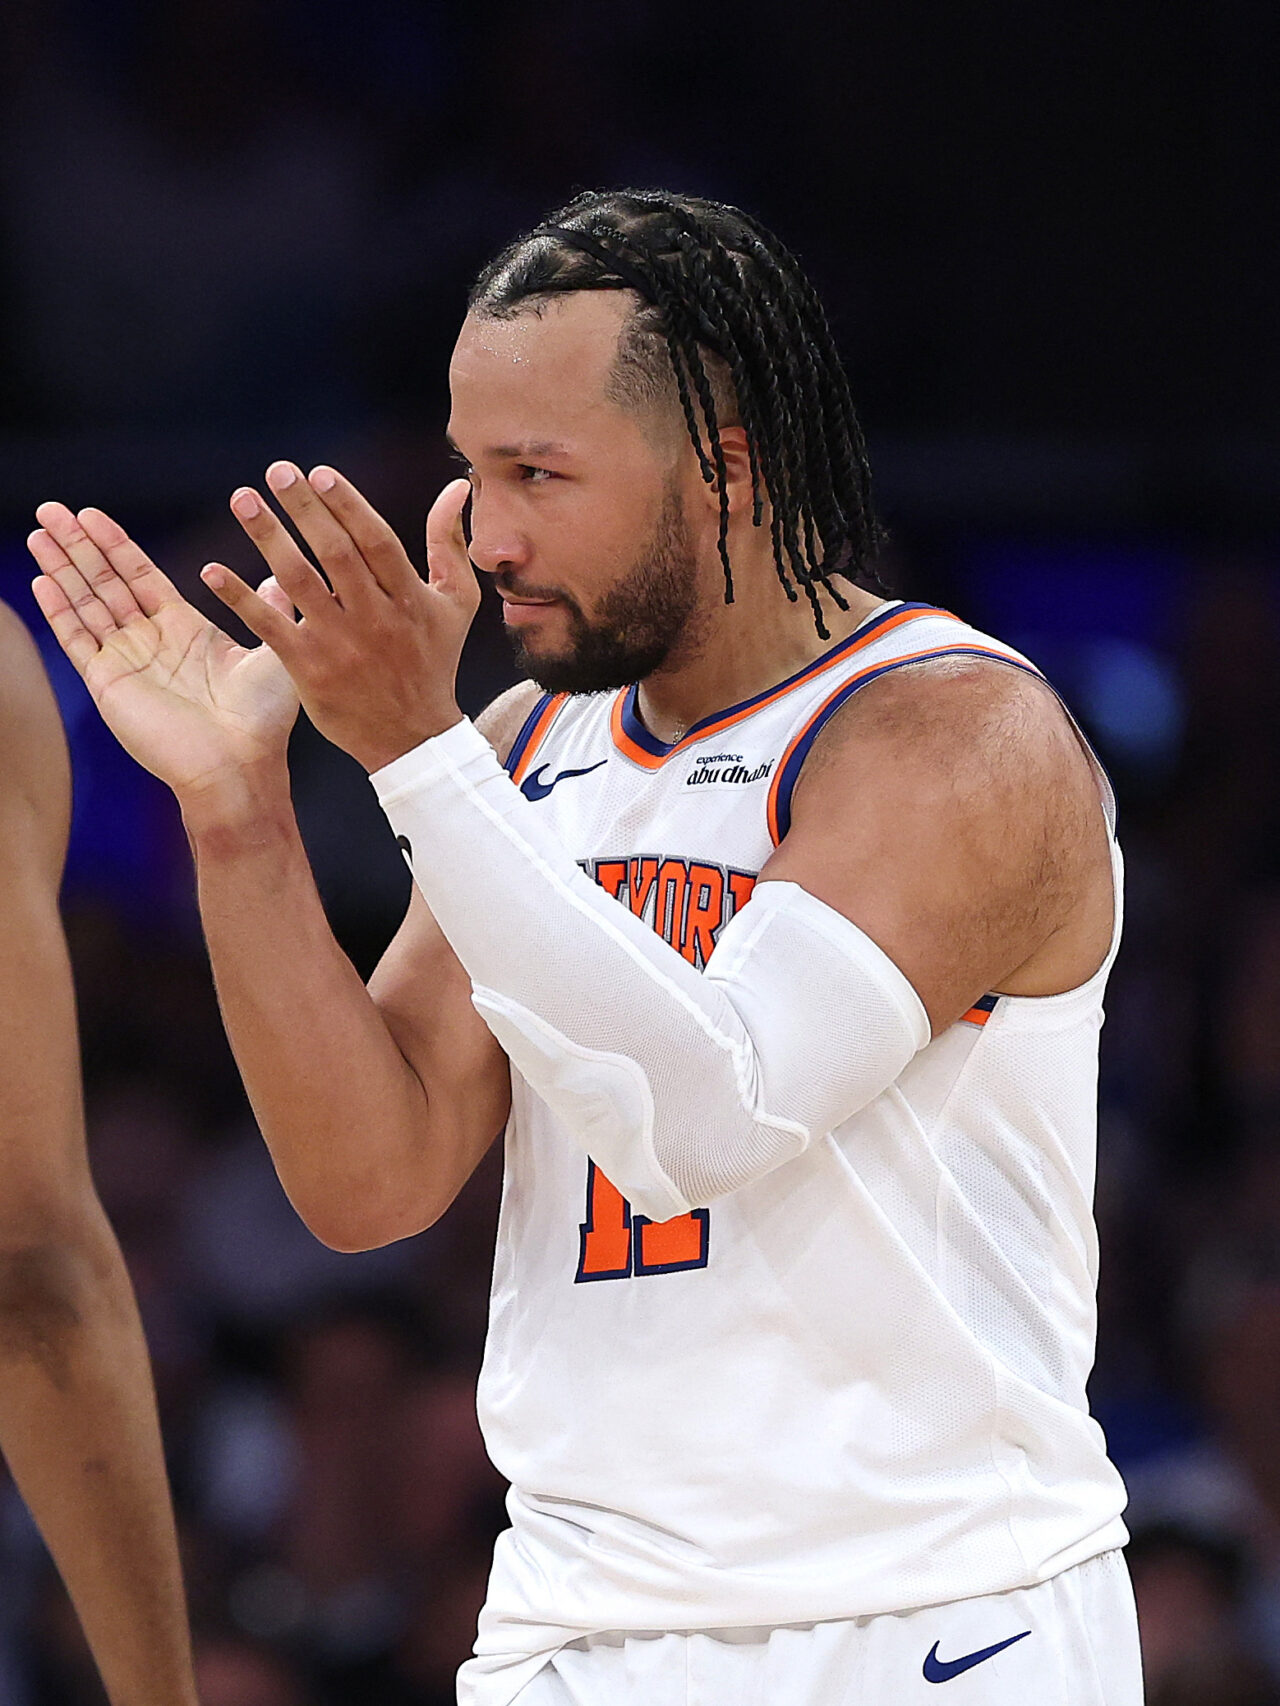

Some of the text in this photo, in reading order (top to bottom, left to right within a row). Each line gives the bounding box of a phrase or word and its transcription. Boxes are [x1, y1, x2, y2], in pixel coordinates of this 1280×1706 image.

[696, 753, 744, 765] experience
[686, 766, 721, 786] abu
[628, 854, 760, 975] YOR
